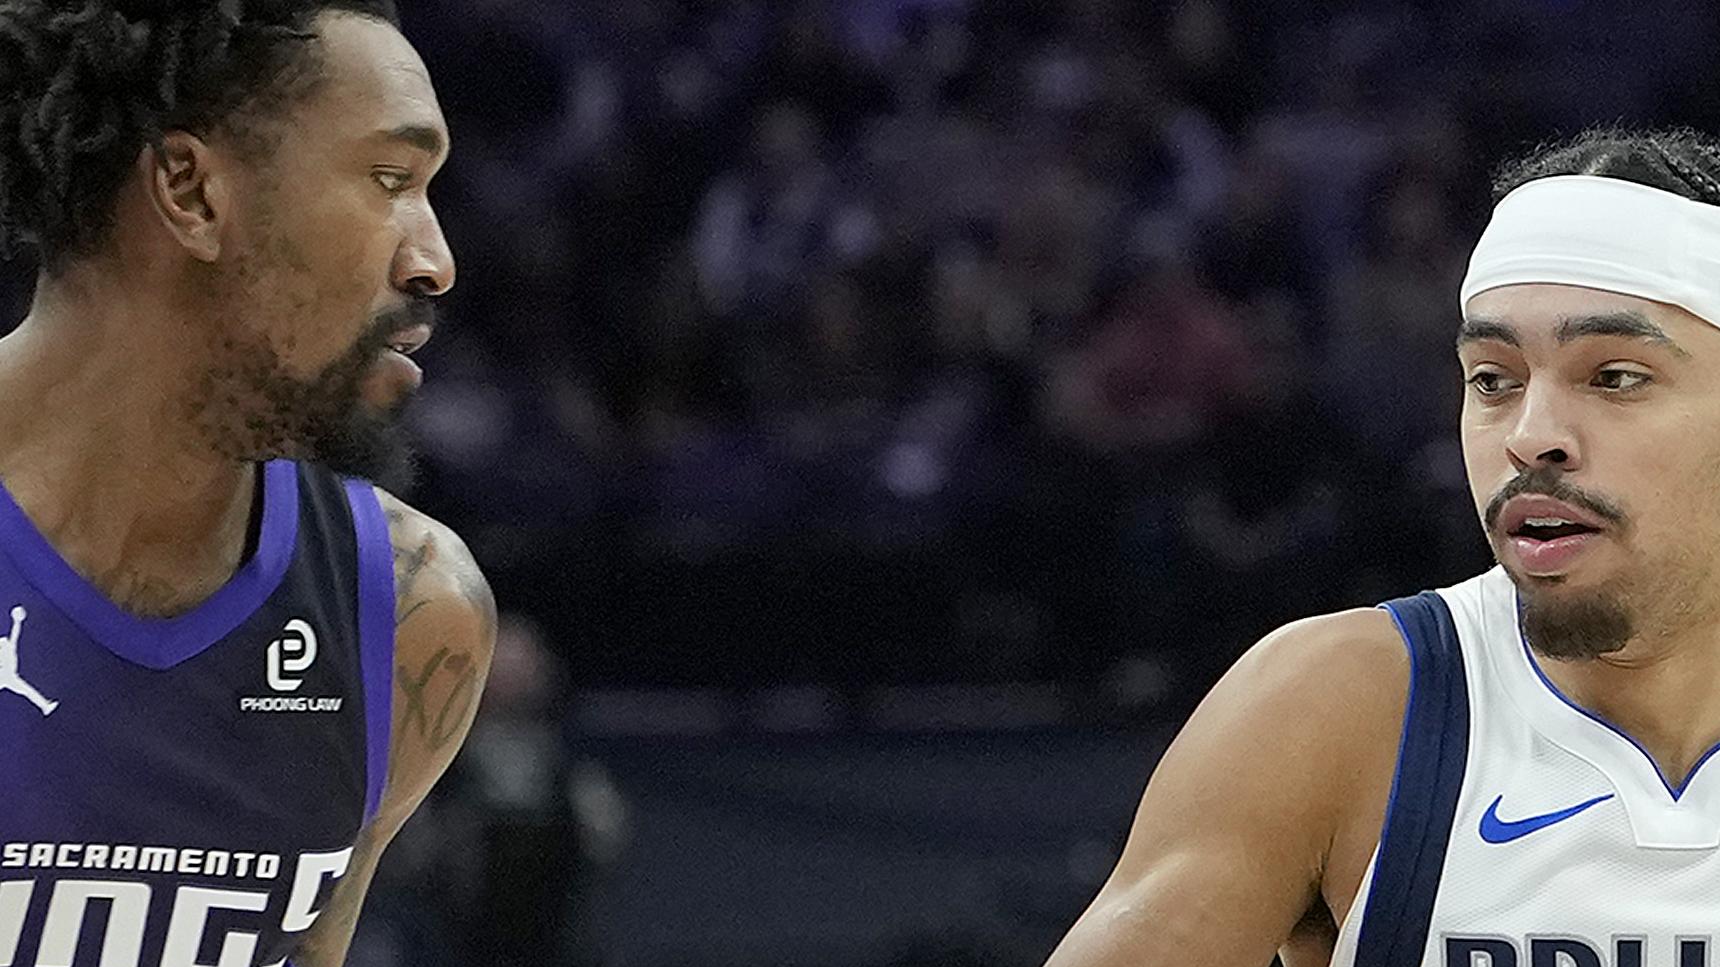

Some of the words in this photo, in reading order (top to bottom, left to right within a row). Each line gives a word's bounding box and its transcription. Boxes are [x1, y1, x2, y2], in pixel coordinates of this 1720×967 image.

[240, 697, 307, 712] PHOONG
[307, 697, 343, 712] LAW
[1, 843, 281, 879] SACRAMENTO
